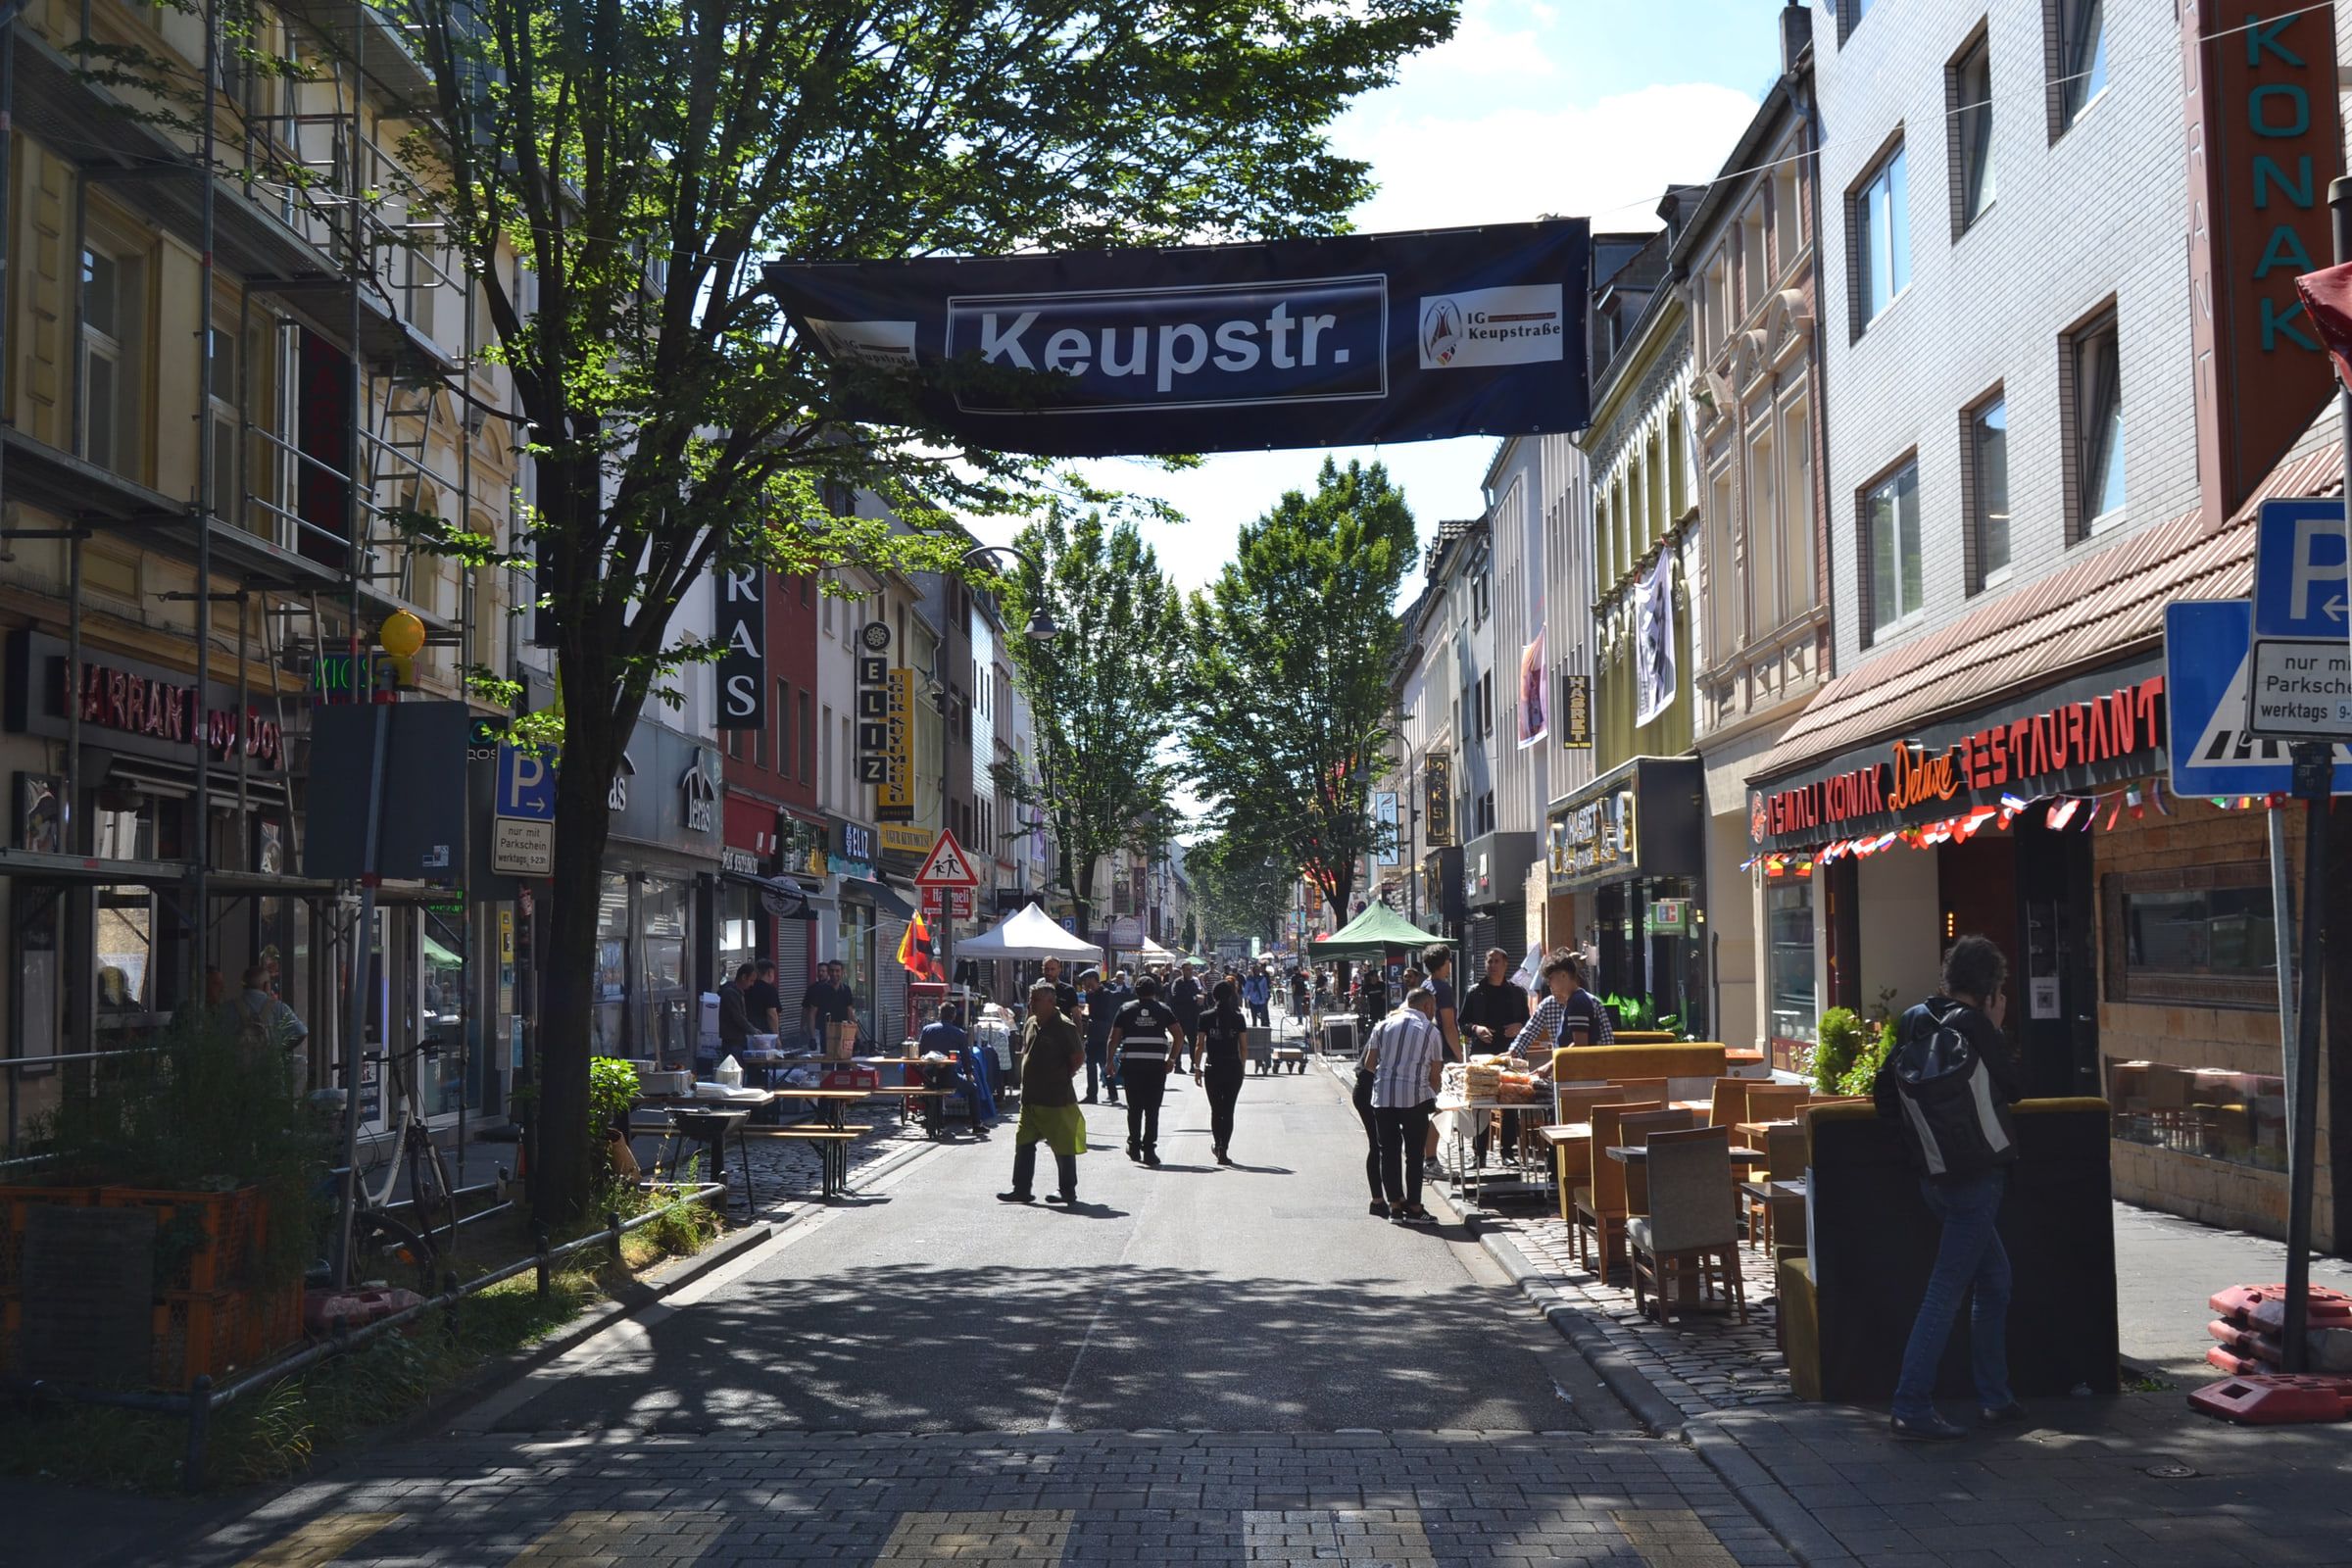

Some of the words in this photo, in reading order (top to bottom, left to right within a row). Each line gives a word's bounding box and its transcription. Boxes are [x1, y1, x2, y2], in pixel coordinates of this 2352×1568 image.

[2246, 14, 2322, 353] KONAK
[1467, 312, 1486, 324] IG
[1468, 322, 1561, 342] Keupstraße
[981, 301, 1349, 393] Keupstr.
[2289, 518, 2349, 620] P
[315, 659, 378, 690] KIOS
[2285, 656, 2318, 671] nur
[867, 662, 881, 779] ELIZ
[1568, 676, 1586, 742] HASRET
[2260, 702, 2328, 722] werktags
[1767, 783, 1819, 836] ASMALI
[1824, 762, 1884, 824] KONAK
[1887, 739, 1959, 812] Deluxe
[1961, 674, 2165, 792] RESTAURANT
[511, 750, 545, 808] P
[500, 838, 547, 851] Parkschein
[508, 827, 522, 837] nur
[526, 828, 540, 838] mit
[853, 826, 869, 859] ELIZ
[498, 854, 527, 865] werktags
